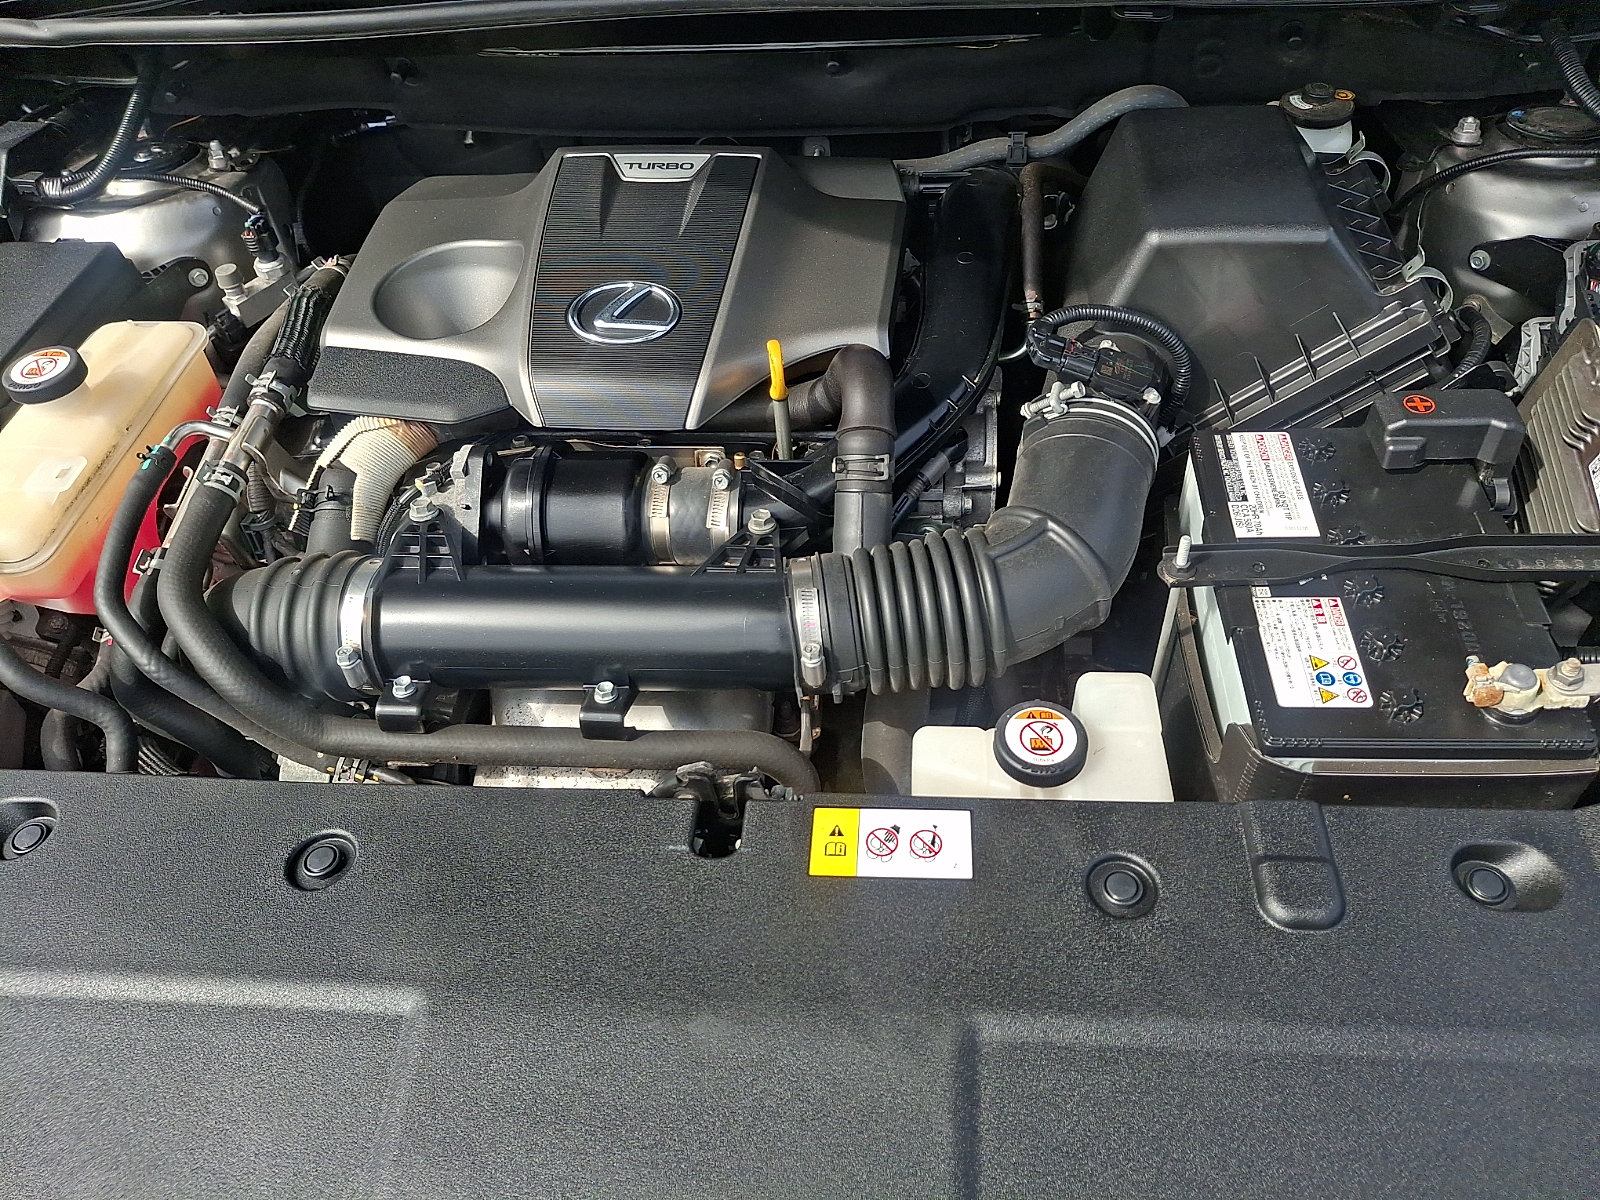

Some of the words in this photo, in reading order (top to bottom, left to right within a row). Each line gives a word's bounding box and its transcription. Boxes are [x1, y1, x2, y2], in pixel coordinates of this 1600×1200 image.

[624, 162, 695, 171] TURBO
[1240, 504, 1251, 518] CCA
[1284, 511, 1293, 521] TIP
